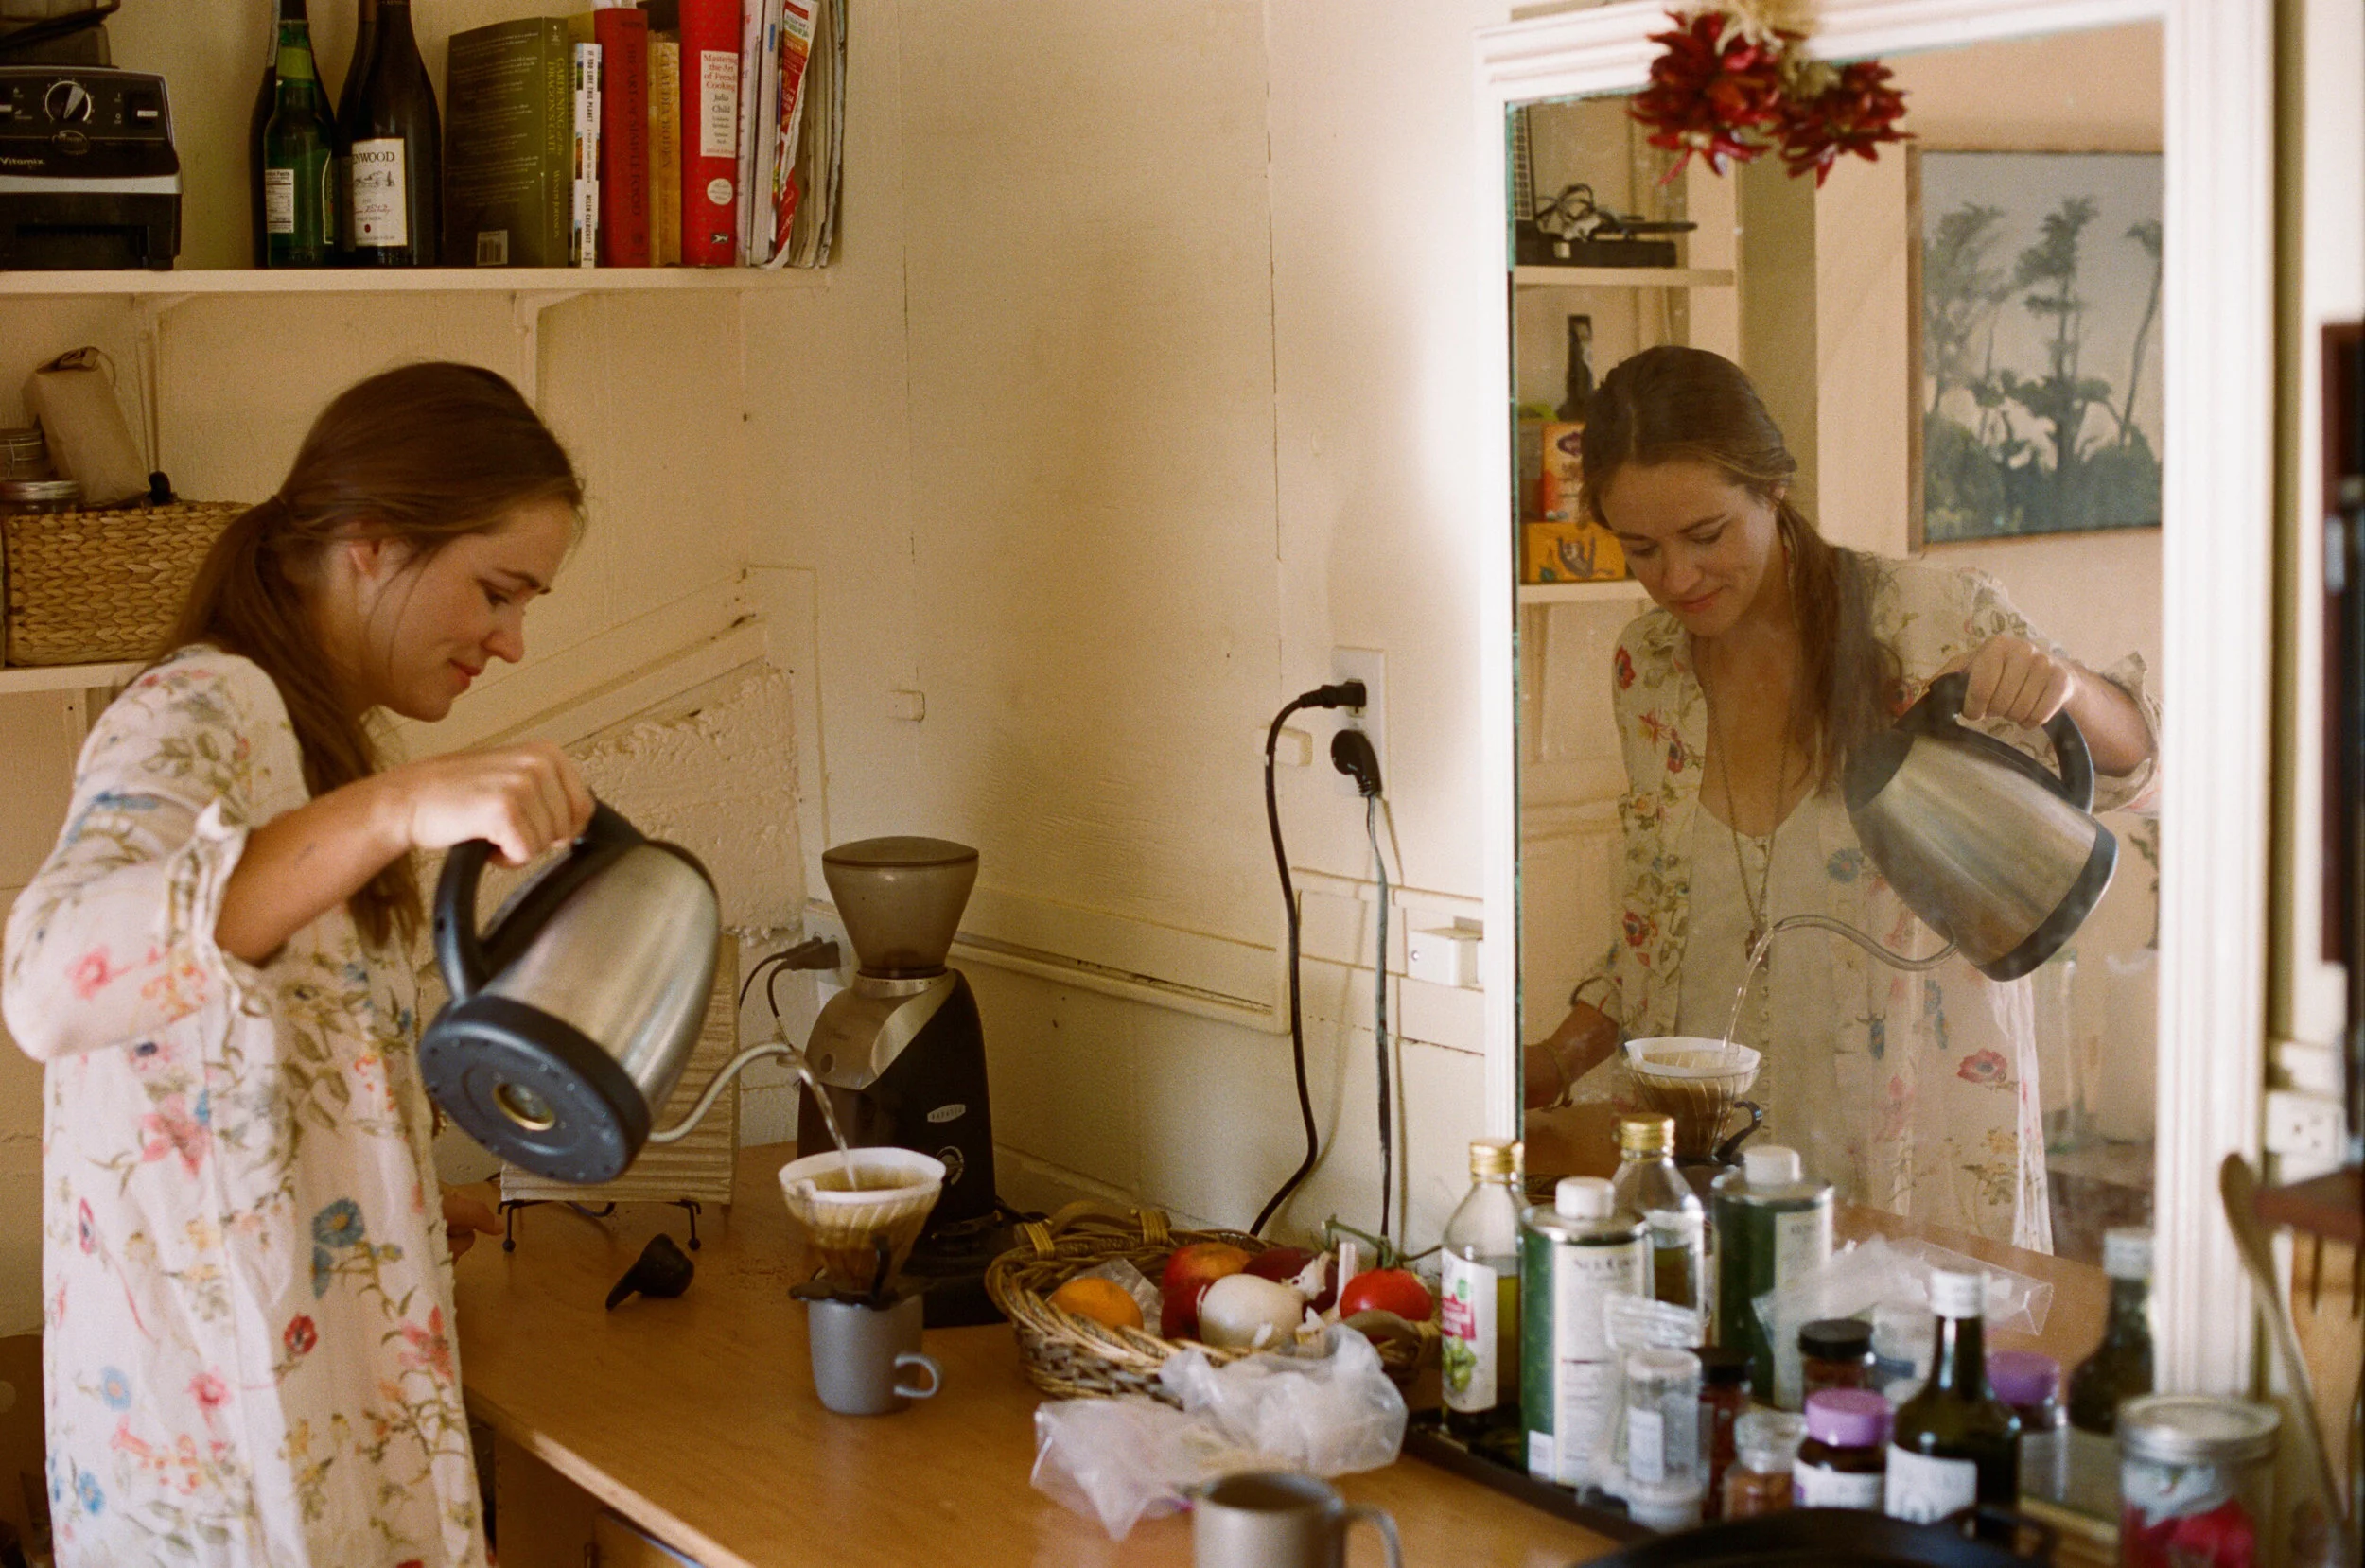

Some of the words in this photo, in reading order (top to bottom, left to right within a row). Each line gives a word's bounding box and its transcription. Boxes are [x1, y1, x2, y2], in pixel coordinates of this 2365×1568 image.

[703, 54, 738, 65] Mastering
[709, 62, 721, 71] the
[627, 69, 639, 96] ART
[661, 53, 671, 115] CLAUDIA
[714, 72, 738, 82] French
[546, 61, 556, 122] DRAGON'S
[555, 57, 566, 129] GARDENING
[706, 81, 735, 93] Cooking
[712, 93, 729, 102] Julia
[711, 104, 731, 114] Child
[546, 123, 556, 156] GATE
[628, 120, 641, 168] SIMPLE
[0, 157, 44, 166] Vitamix
[351, 151, 395, 164] ENWOOD
[585, 194, 593, 213] HELEN
[630, 174, 642, 217] FOOD
